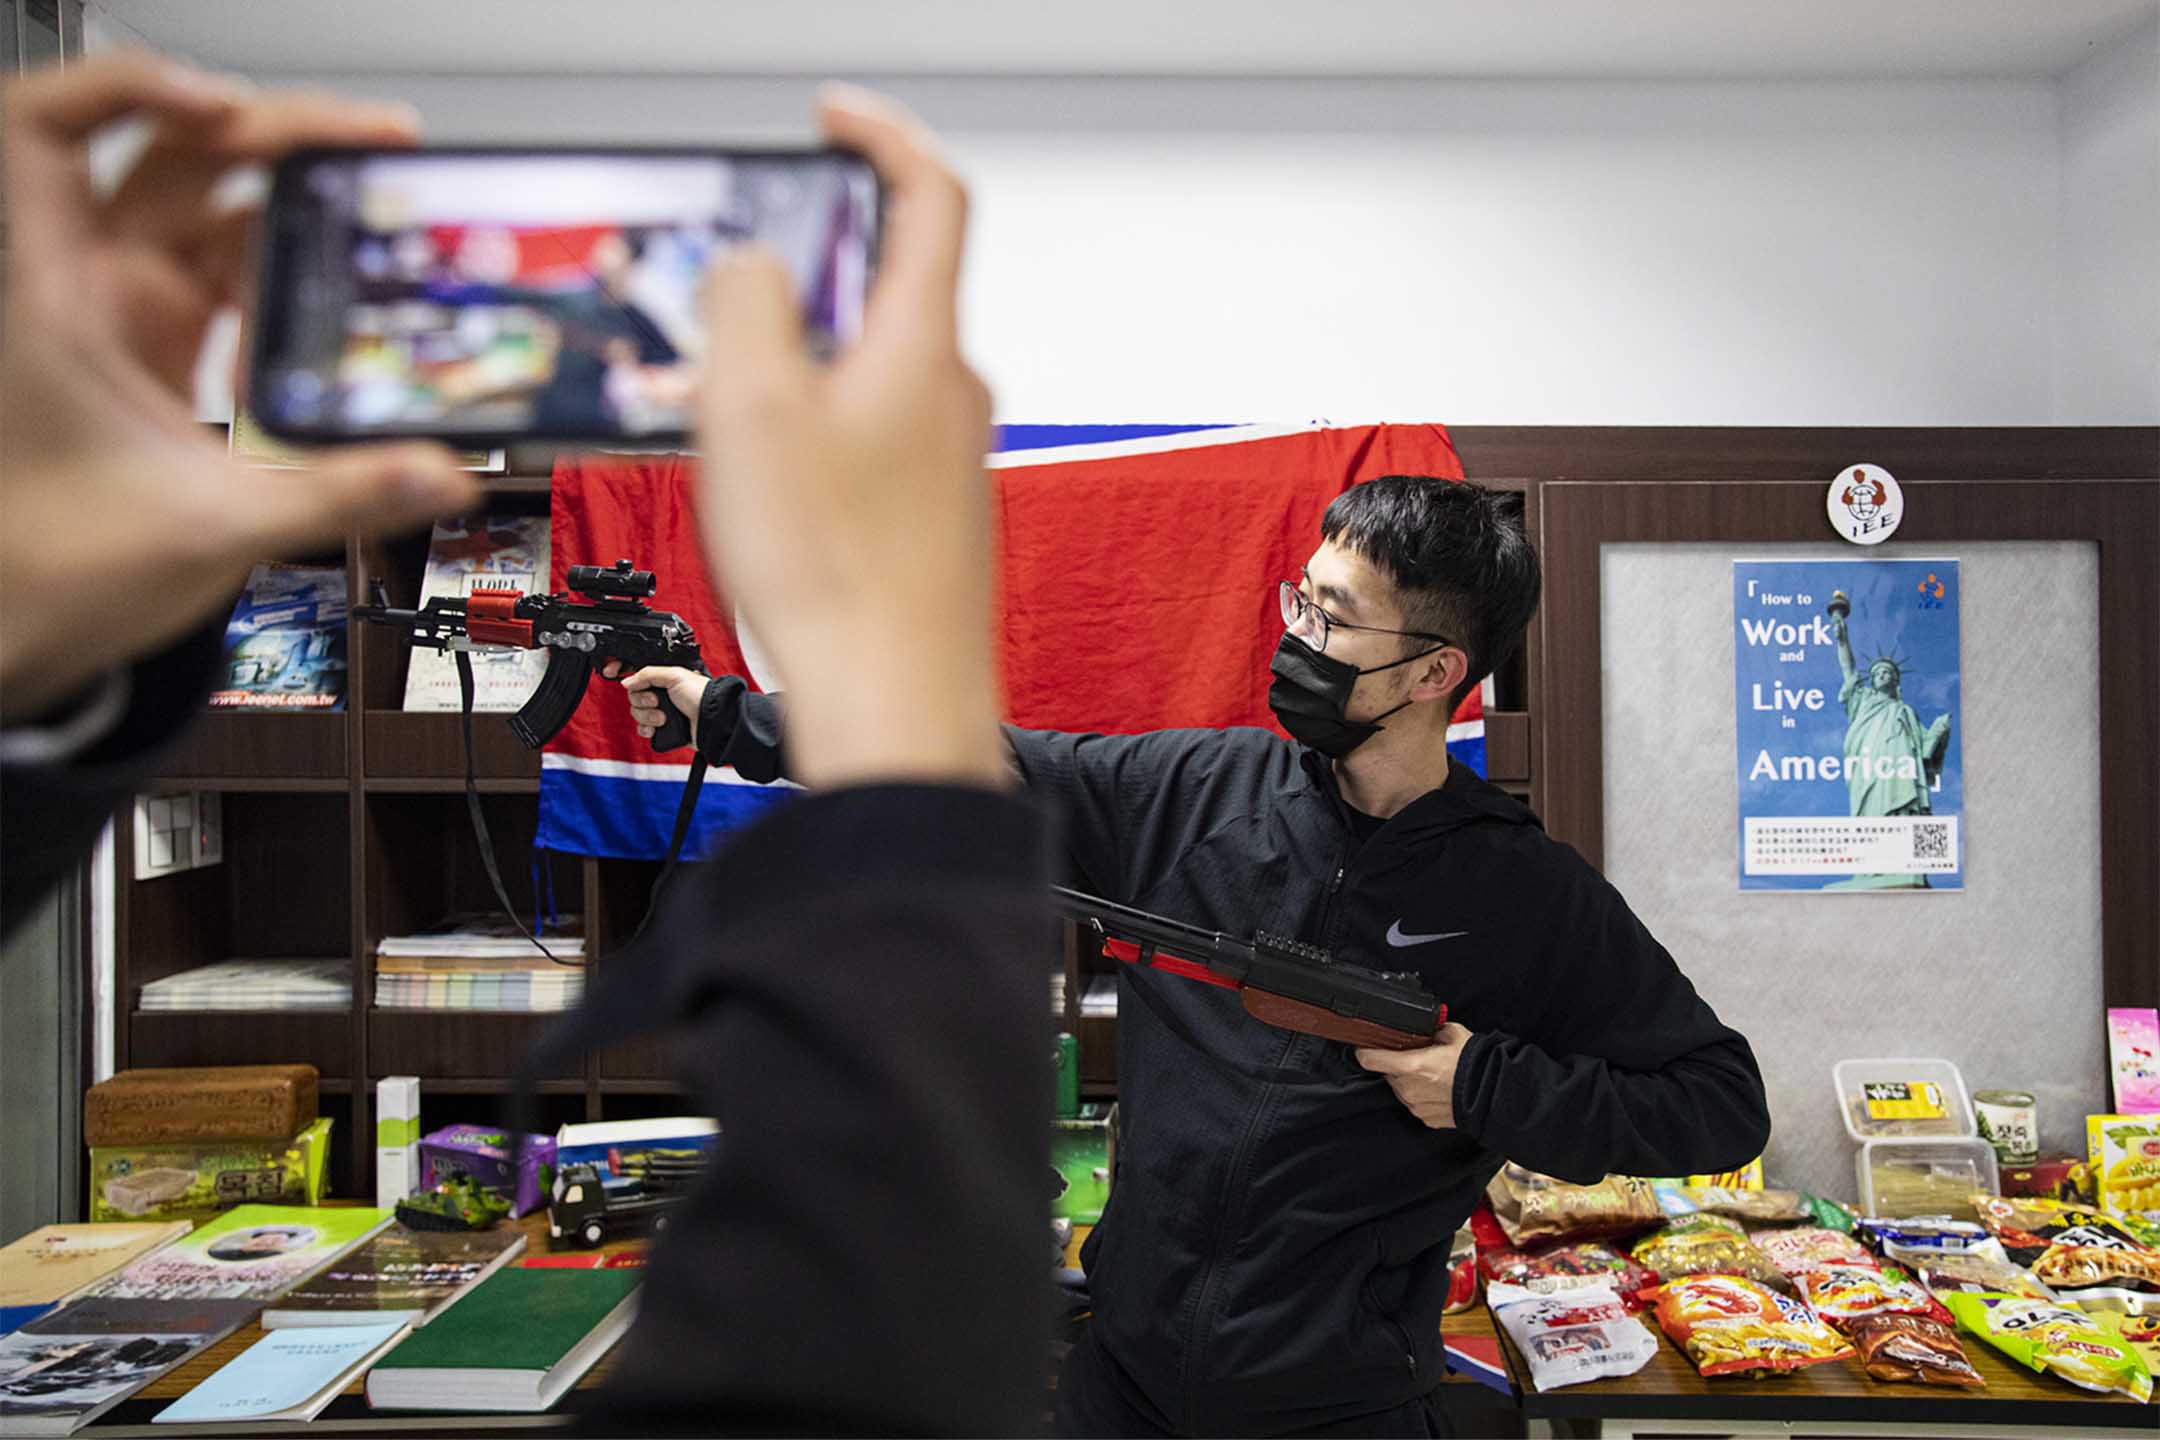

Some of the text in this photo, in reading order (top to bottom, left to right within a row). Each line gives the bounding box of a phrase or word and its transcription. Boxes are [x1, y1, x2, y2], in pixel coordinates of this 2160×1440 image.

[1852, 512, 1896, 537] IEE
[1761, 593, 1812, 605] How to
[1741, 616, 1833, 647] Work
[1779, 649, 1805, 662] and
[1752, 680, 1825, 711] Live
[1782, 715, 1796, 729] in
[1749, 749, 1918, 781] America
